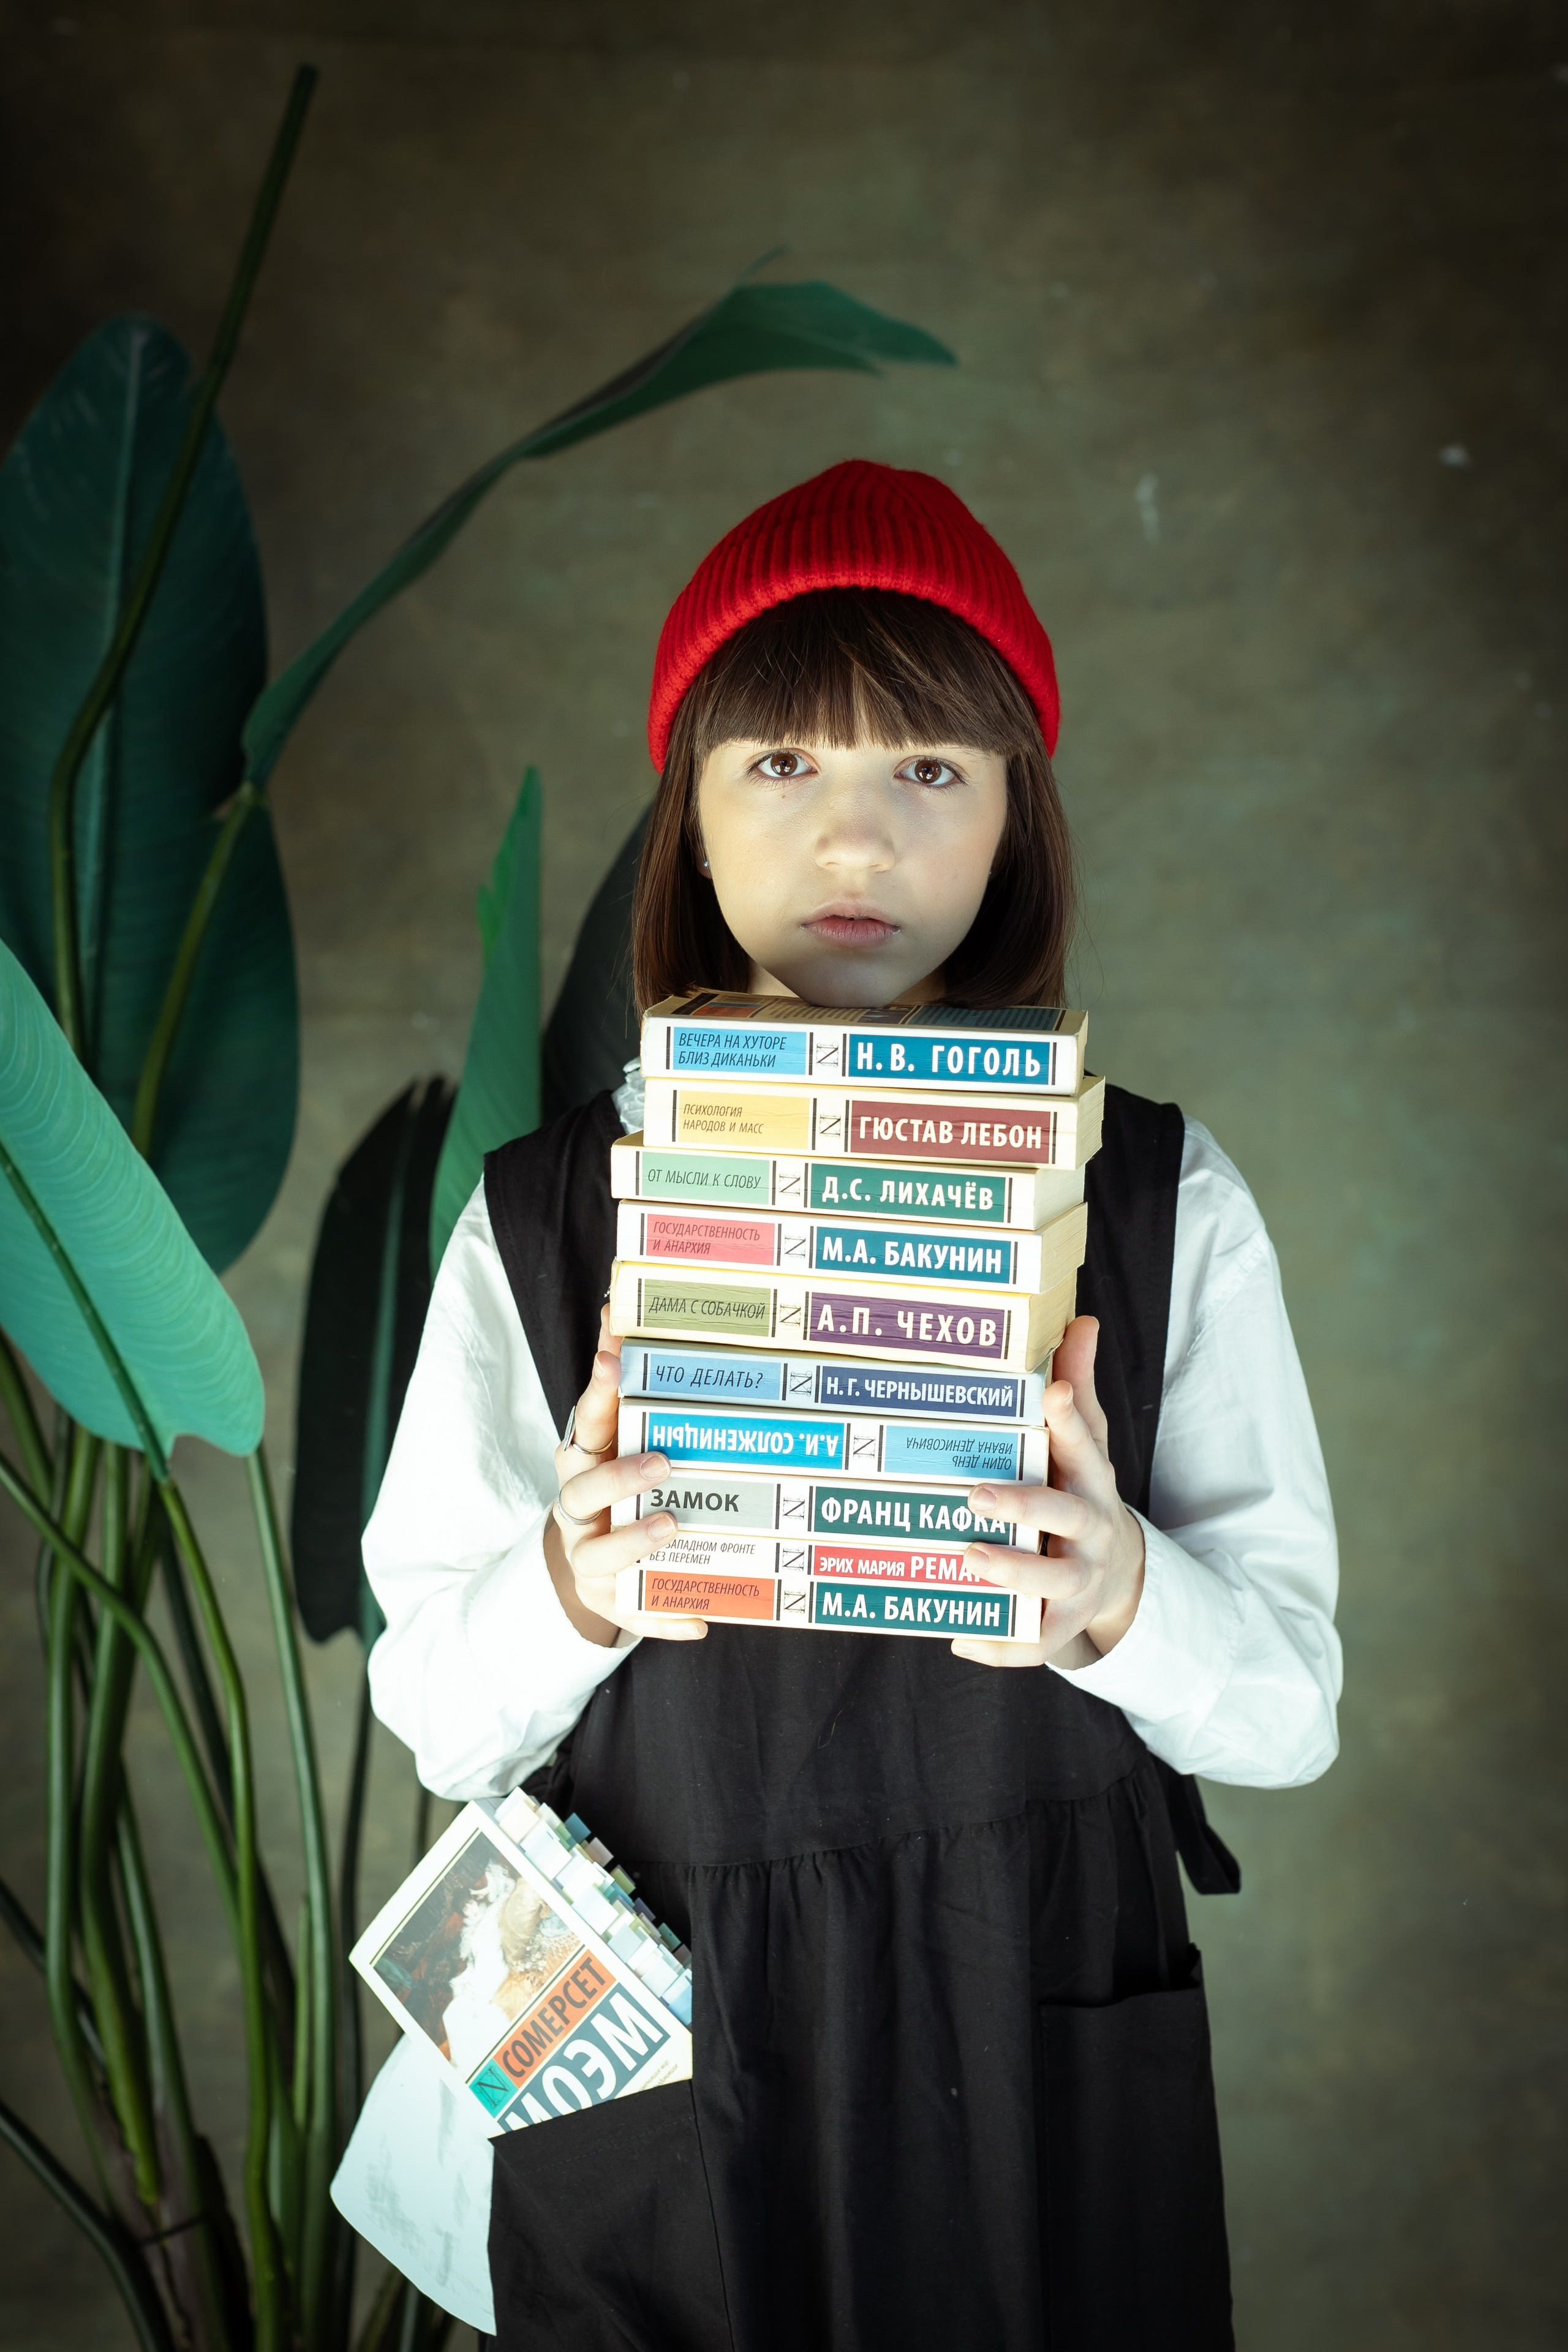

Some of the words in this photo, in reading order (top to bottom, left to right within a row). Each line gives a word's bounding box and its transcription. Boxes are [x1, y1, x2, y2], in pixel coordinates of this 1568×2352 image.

[679, 1033, 721, 1048] ВЕЧЕРА
[725, 1035, 741, 1048] НА
[742, 1036, 787, 1050] ХУТОРЕ
[679, 1051, 709, 1065] БЛИЗ
[711, 1053, 776, 1068] ДИКАНЬКИ
[932, 1045, 1041, 1076] ГОГОЛЬ
[684, 1104, 742, 1117] ПСИХОЛОГИЯ
[684, 1120, 725, 1132] НАРОДОВ
[729, 1122, 736, 1132] И
[739, 1123, 764, 1134] МАСС
[859, 1116, 953, 1144] ГЮСТАВ
[960, 1122, 1041, 1149] ЛЕБОН
[648, 1169, 663, 1182] ОТ
[665, 1170, 709, 1186] МЫСЛИ
[712, 1174, 720, 1186] К
[724, 1174, 761, 1189] СЛОВУ
[880, 1180, 993, 1210] ЛИХАЧЁВ
[654, 1222, 760, 1241] ГОСУДАРСТВЕННОСТЬ
[653, 1241, 660, 1251] И
[664, 1241, 711, 1254] АНАРХИЯ
[884, 1242, 1001, 1274] БАКУНИН
[649, 1297, 686, 1313] ДАМА
[691, 1300, 699, 1313] С
[701, 1300, 766, 1319] СОБАЧКОЙ
[897, 1310, 997, 1346] ЧЕХОВ
[656, 1365, 685, 1383] ЧТО
[690, 1368, 763, 1389] ДЕЛАТЬ?
[864, 1379, 1013, 1407] ЧЕРНЫШЕВСКИЙ
[653, 1423, 794, 1453] СОЛЖЕНИЦЫН
[906, 1437, 975, 1452] ДЕНИСОВИЧА
[978, 1441, 1013, 1455] ИВАНА
[952, 1455, 979, 1468] ДЕНЬ
[982, 1456, 1012, 1471] ОДИН
[650, 1489, 740, 1512] ЗАМОК
[821, 1497, 911, 1532] ФРАНЦ
[669, 1552, 710, 1564] ПЕРЕМЕН
[720, 1542, 756, 1555] ФРОНТЕ
[819, 1556, 854, 1574] ЭРИХ
[858, 1559, 905, 1576] МАРИЯ
[652, 1578, 760, 1597] ГОСУДАРСТВЕННОСТЬ
[651, 1596, 658, 1607] И
[663, 1597, 710, 1610] АНАРХИЯ
[884, 1596, 1000, 1627] БАКУНИН
[503, 1958, 606, 2078] СОМЕРСЕТ
